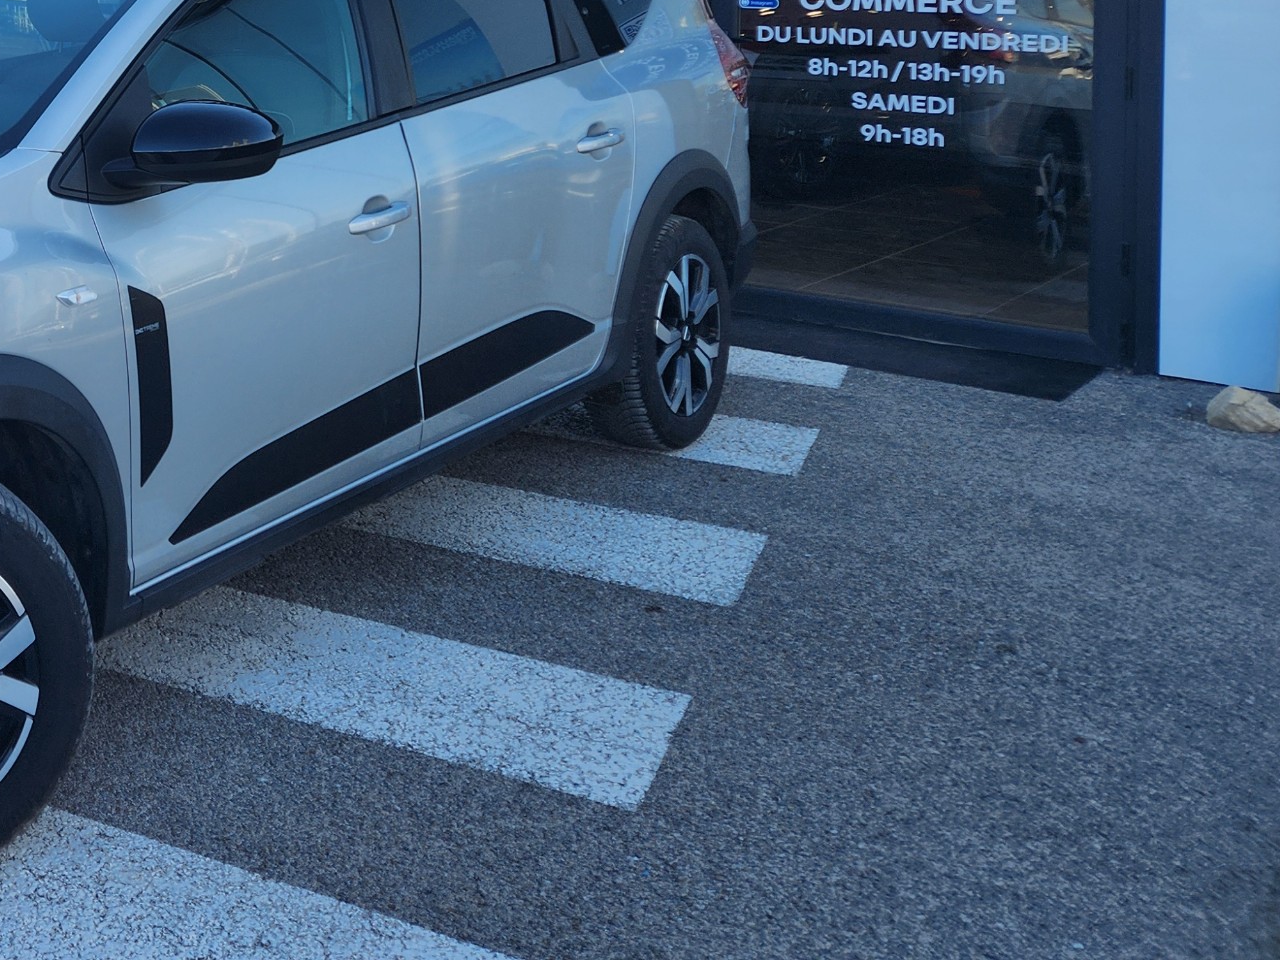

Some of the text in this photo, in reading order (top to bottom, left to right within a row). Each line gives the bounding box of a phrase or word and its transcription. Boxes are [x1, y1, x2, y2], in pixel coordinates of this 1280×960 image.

[756, 25, 1070, 53] DU LUNDI AU VENDREDI
[851, 91, 955, 115] SAMEDI
[860, 123, 946, 148] 9h-18h
